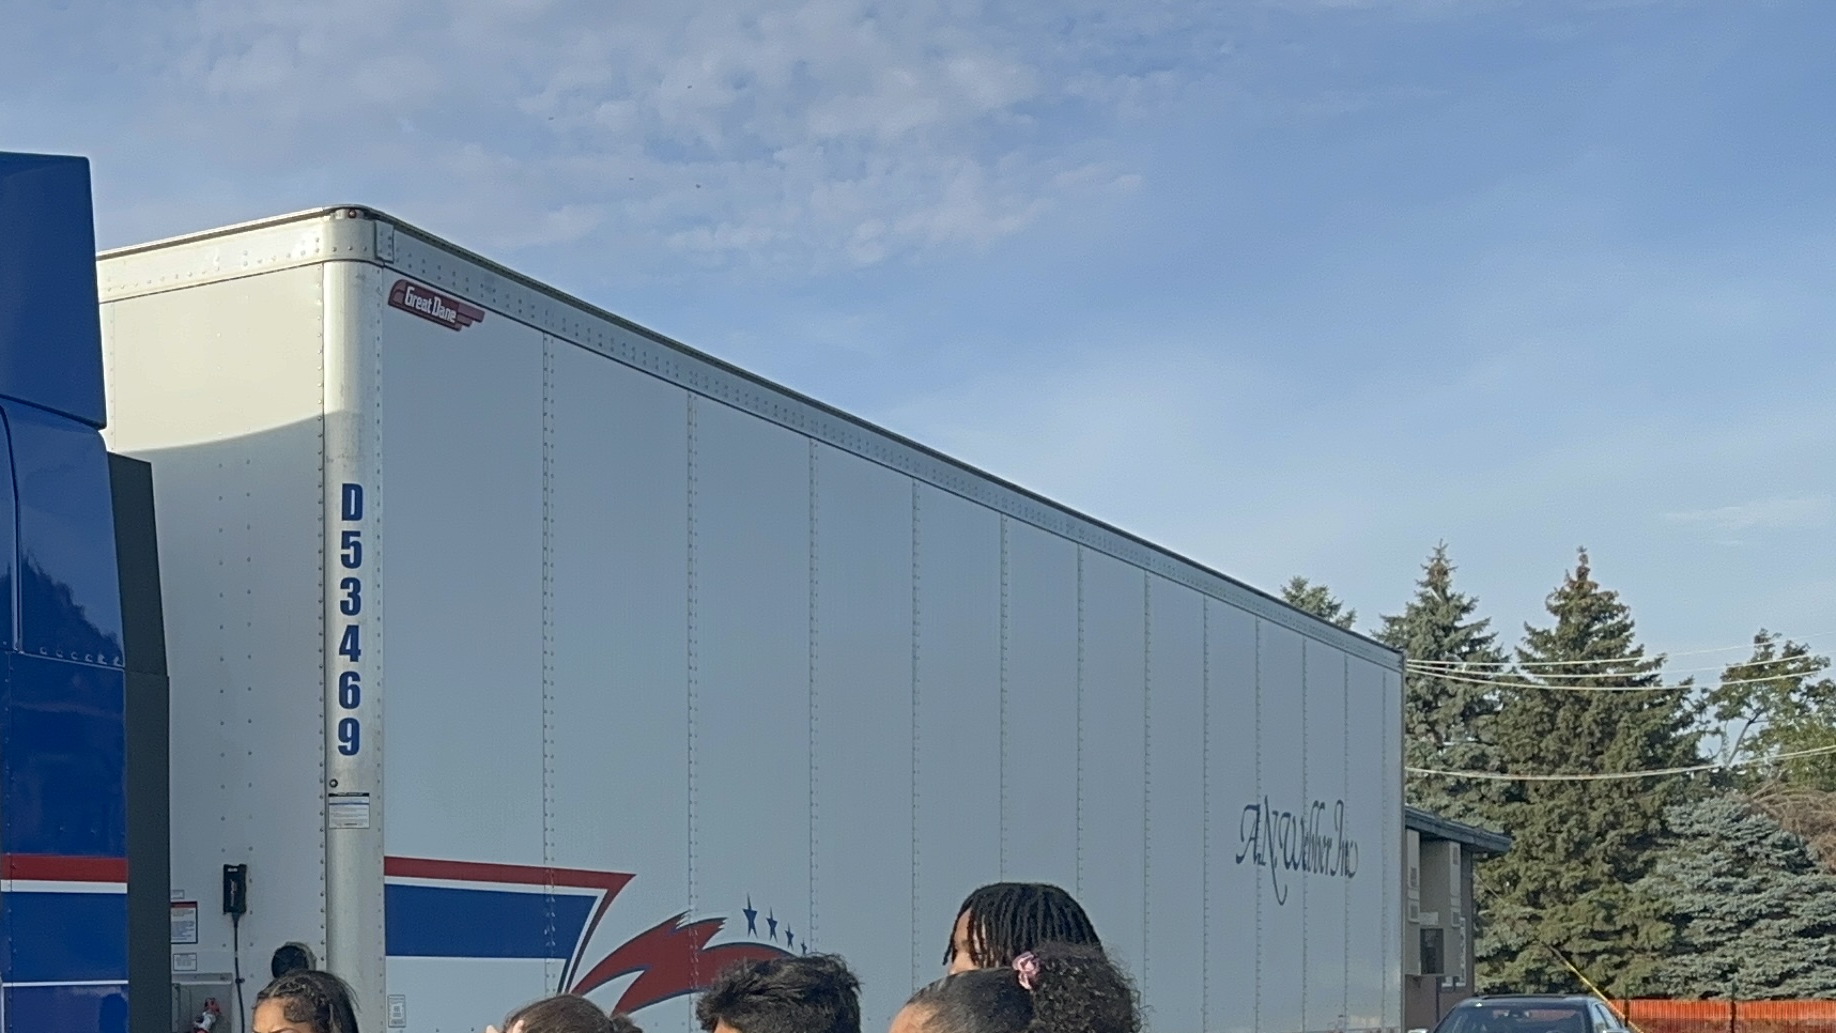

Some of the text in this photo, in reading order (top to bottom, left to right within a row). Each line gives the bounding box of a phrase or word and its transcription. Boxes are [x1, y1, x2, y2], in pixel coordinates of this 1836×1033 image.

[404, 285, 457, 323] Great Dane
[337, 482, 364, 756] D53469
